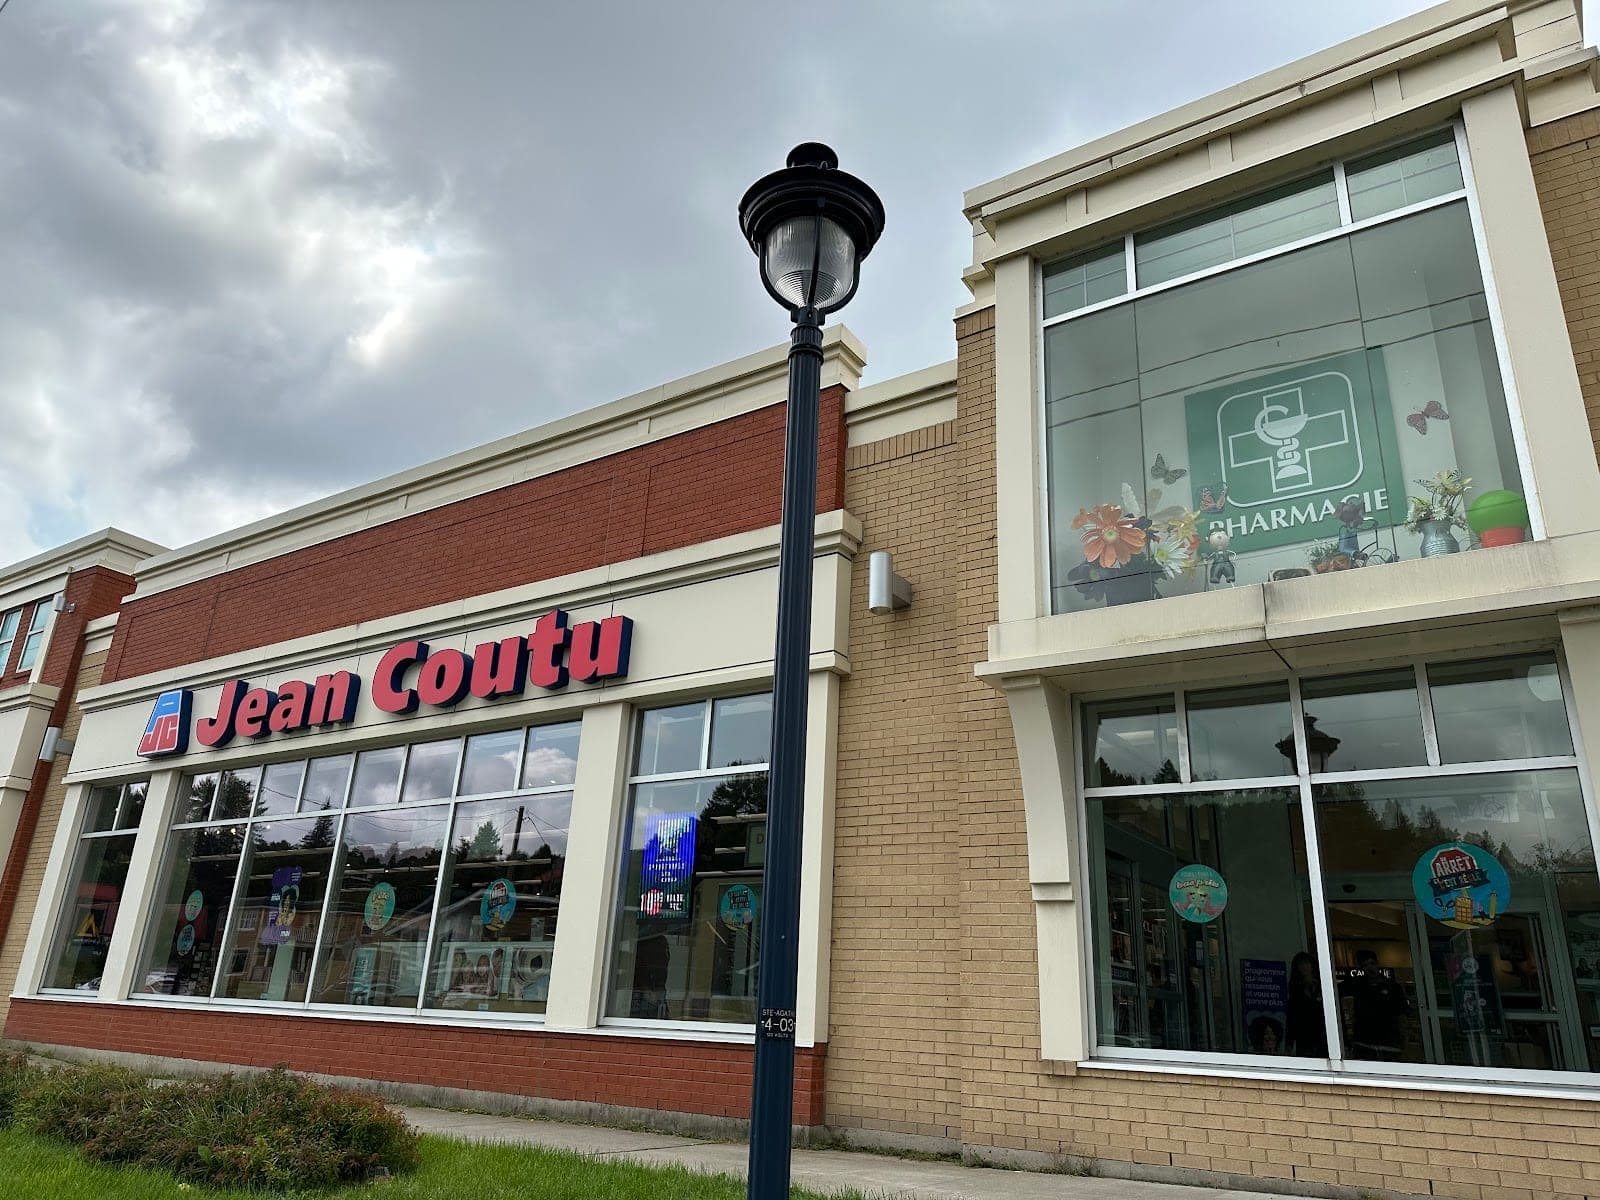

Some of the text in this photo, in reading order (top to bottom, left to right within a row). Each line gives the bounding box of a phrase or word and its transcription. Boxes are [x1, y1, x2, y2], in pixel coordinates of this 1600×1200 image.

[196, 609, 631, 747] Jean Coutu
[762, 1008, 793, 1017] STE-AGAT
